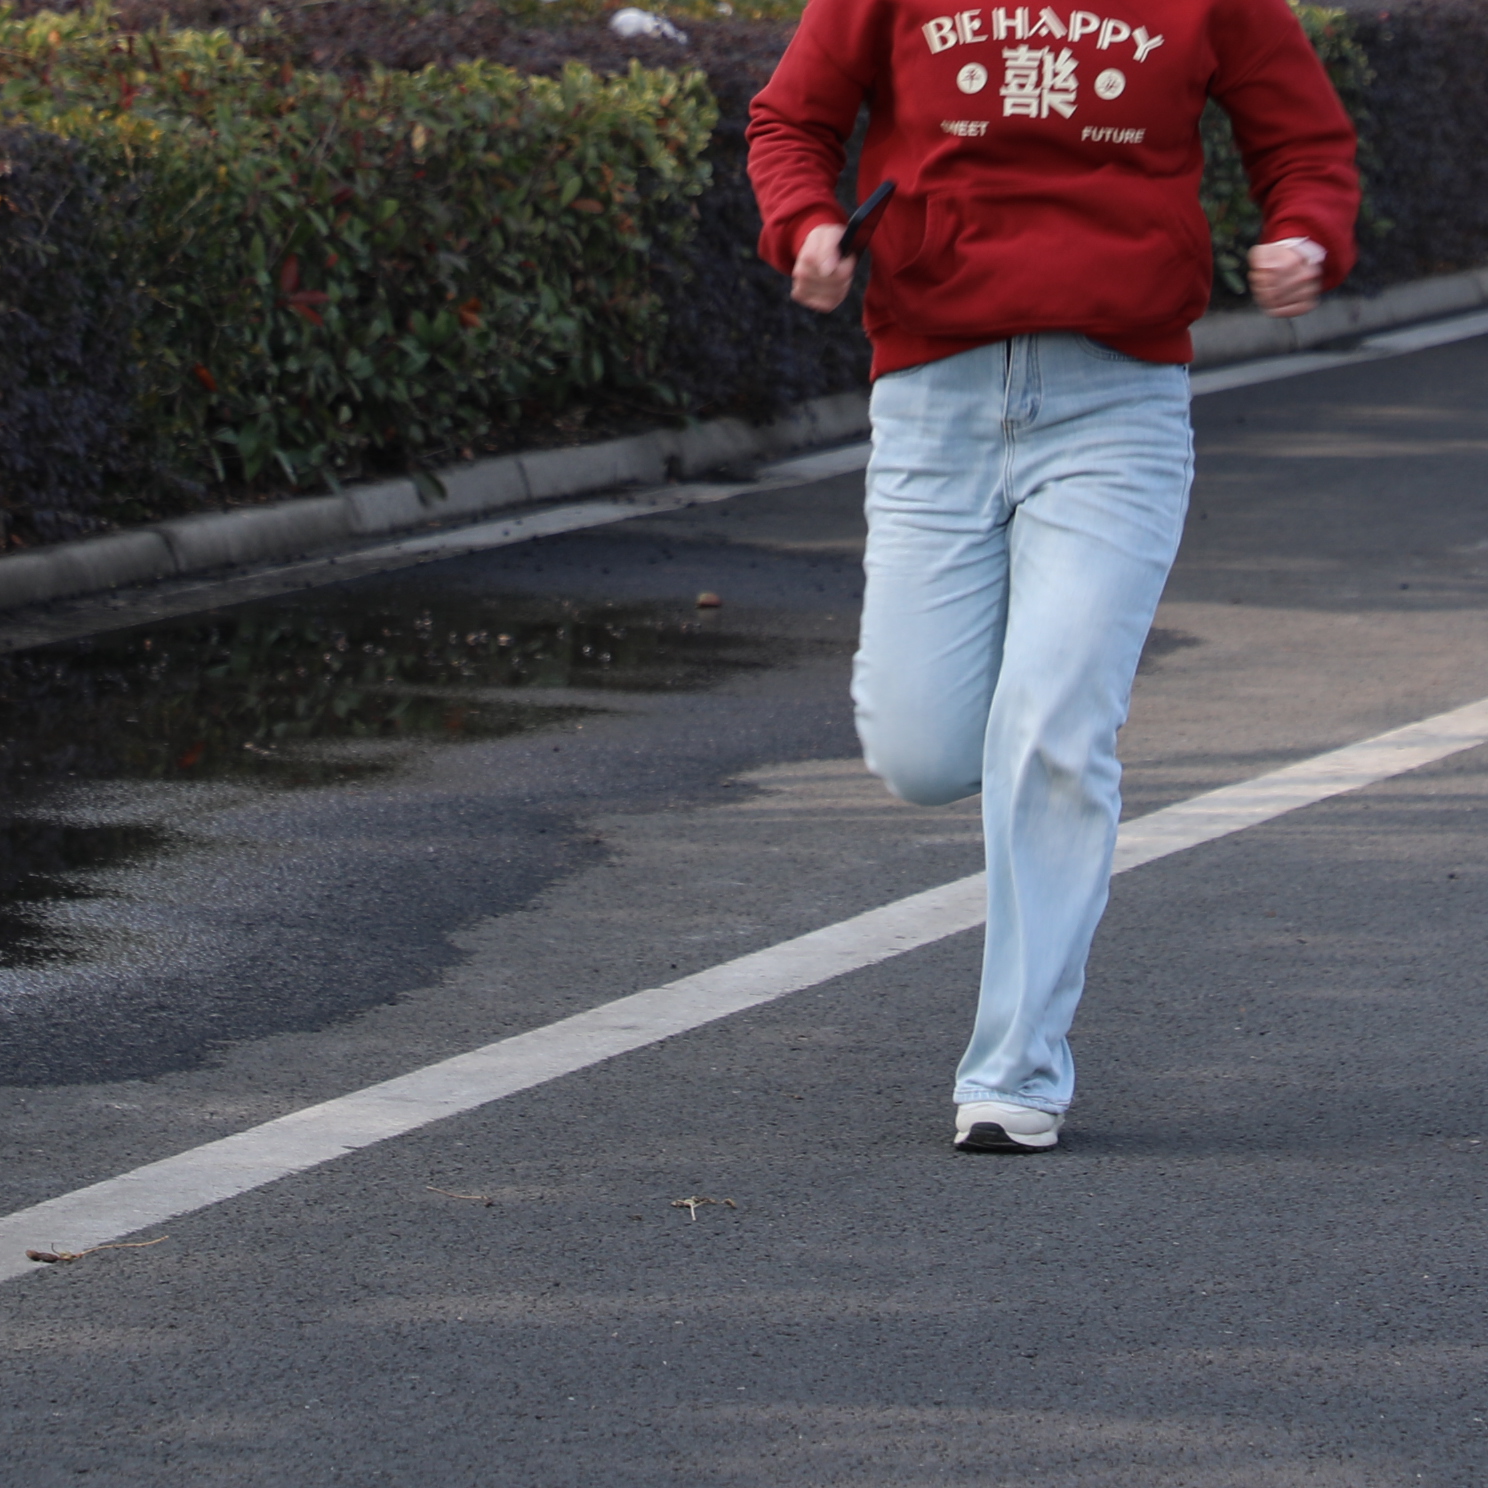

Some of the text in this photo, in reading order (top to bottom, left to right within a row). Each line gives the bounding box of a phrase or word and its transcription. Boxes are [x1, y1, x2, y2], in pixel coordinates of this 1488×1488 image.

[922, 5, 1165, 63] BE HAPPY
[1081, 125, 1147, 144] FUTURE
